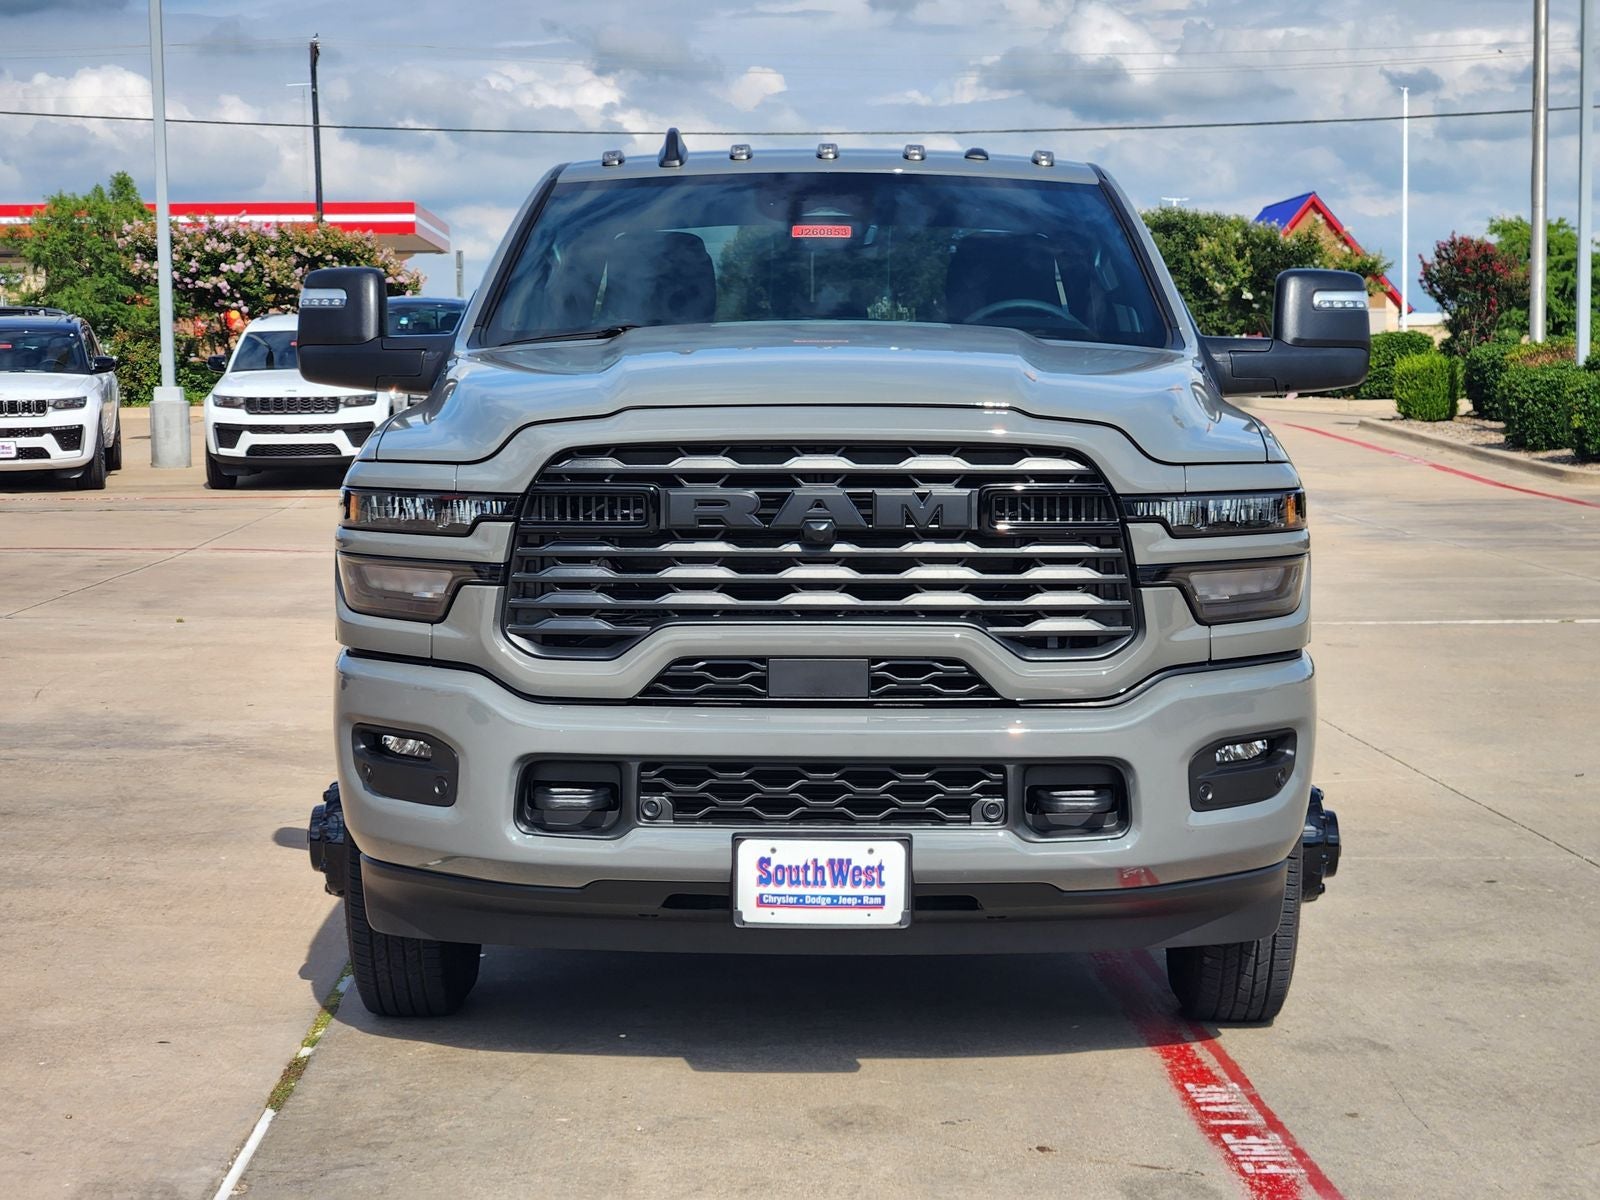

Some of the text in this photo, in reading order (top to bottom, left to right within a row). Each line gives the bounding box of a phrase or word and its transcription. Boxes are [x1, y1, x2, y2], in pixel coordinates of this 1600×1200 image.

[665, 488, 973, 529] RAM
[756, 856, 886, 889] SouthWest
[762, 894, 881, 905] Chrysler Dodge Jeep Ram
